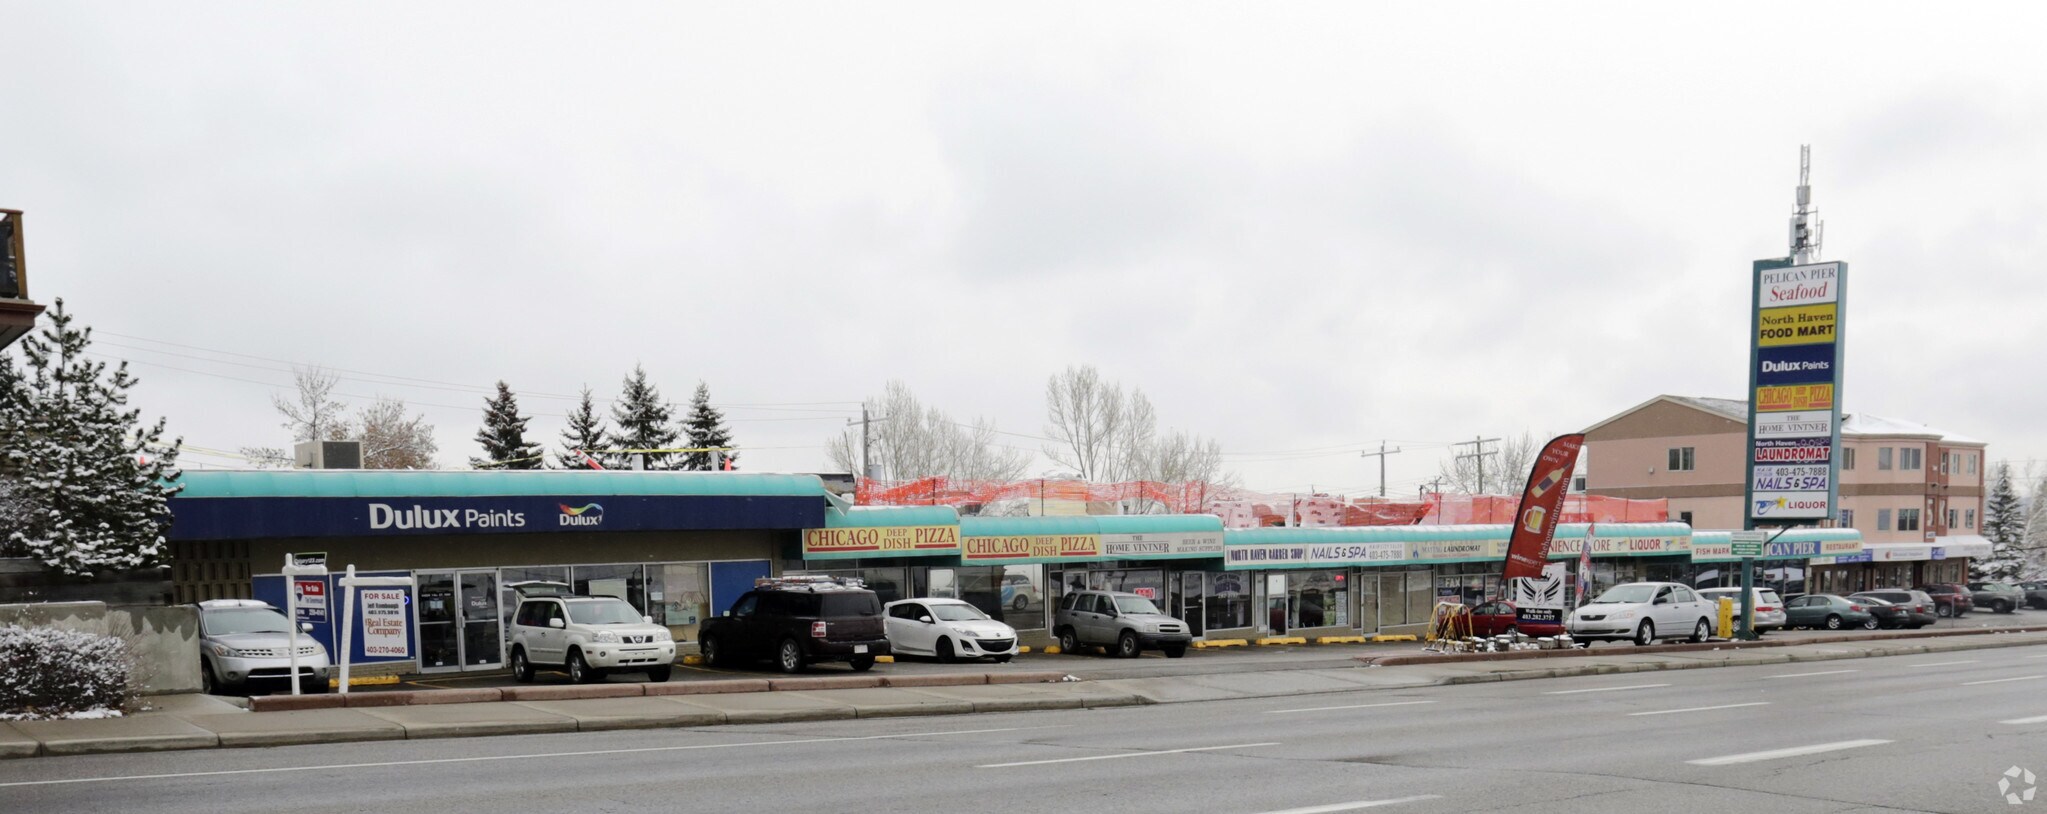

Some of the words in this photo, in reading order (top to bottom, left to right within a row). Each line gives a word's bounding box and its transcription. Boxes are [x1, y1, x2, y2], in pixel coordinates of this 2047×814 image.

[1764, 270, 1806, 284] PELICAN
[1811, 268, 1836, 280] PIER
[1770, 282, 1828, 302] Seafood
[1762, 314, 1794, 326] North
[1798, 313, 1833, 322] Haven
[1760, 328, 1793, 339] FOOD
[1798, 324, 1834, 336] MART
[1762, 360, 1800, 372] Dulux
[1802, 361, 1830, 370] Paints
[1758, 388, 1792, 404] CHICAGO
[1810, 386, 1830, 402] PIZZA
[1758, 424, 1784, 434] HOME
[1788, 422, 1828, 432] VINTNER
[1552, 448, 1569, 457] YOUR
[1755, 447, 1830, 462] LAUNDROMAT
[1543, 455, 1559, 463] OWN
[1776, 467, 1827, 476] 403-475-7888
[1756, 478, 1793, 489] NAILS
[1794, 479, 1800, 488] &
[1801, 477, 1826, 489] SPA
[369, 504, 460, 529] Dulux
[465, 510, 526, 528] Paints
[560, 514, 598, 526] Dulux
[1538, 477, 1570, 559] thehomevintner.com
[807, 529, 878, 546] CHICAGO
[886, 529, 908, 537] DEEP
[914, 528, 956, 544] PIZZA
[883, 538, 910, 549] DISH
[966, 538, 1029, 554] CHICAGO
[1033, 546, 1057, 557] DISH
[1060, 537, 1096, 551] PIZZA
[1106, 544, 1130, 554] HOME
[1133, 543, 1169, 553] VINTNER
[1594, 539, 1611, 551] ORE
[1630, 539, 1660, 550] LIQUOR
[1766, 543, 1790, 556] ICAN
[1793, 542, 1815, 554] PIER
[1826, 542, 1858, 550] RESTAURANT
[1230, 549, 1248, 561] NORTH
[1250, 549, 1267, 560] HAVEN
[1268, 548, 1288, 560] BARBER
[1291, 548, 1303, 559] SHOP
[1310, 547, 1340, 559] NAILS
[1342, 548, 1347, 557] &
[1347, 546, 1367, 558] SPA
[1369, 550, 1402, 559] 403-475-7888
[1511, 553, 1542, 567] winexpert
[1445, 578, 1460, 587] FAX
[368, 618, 381, 627] Real
[368, 627, 401, 638] Company
